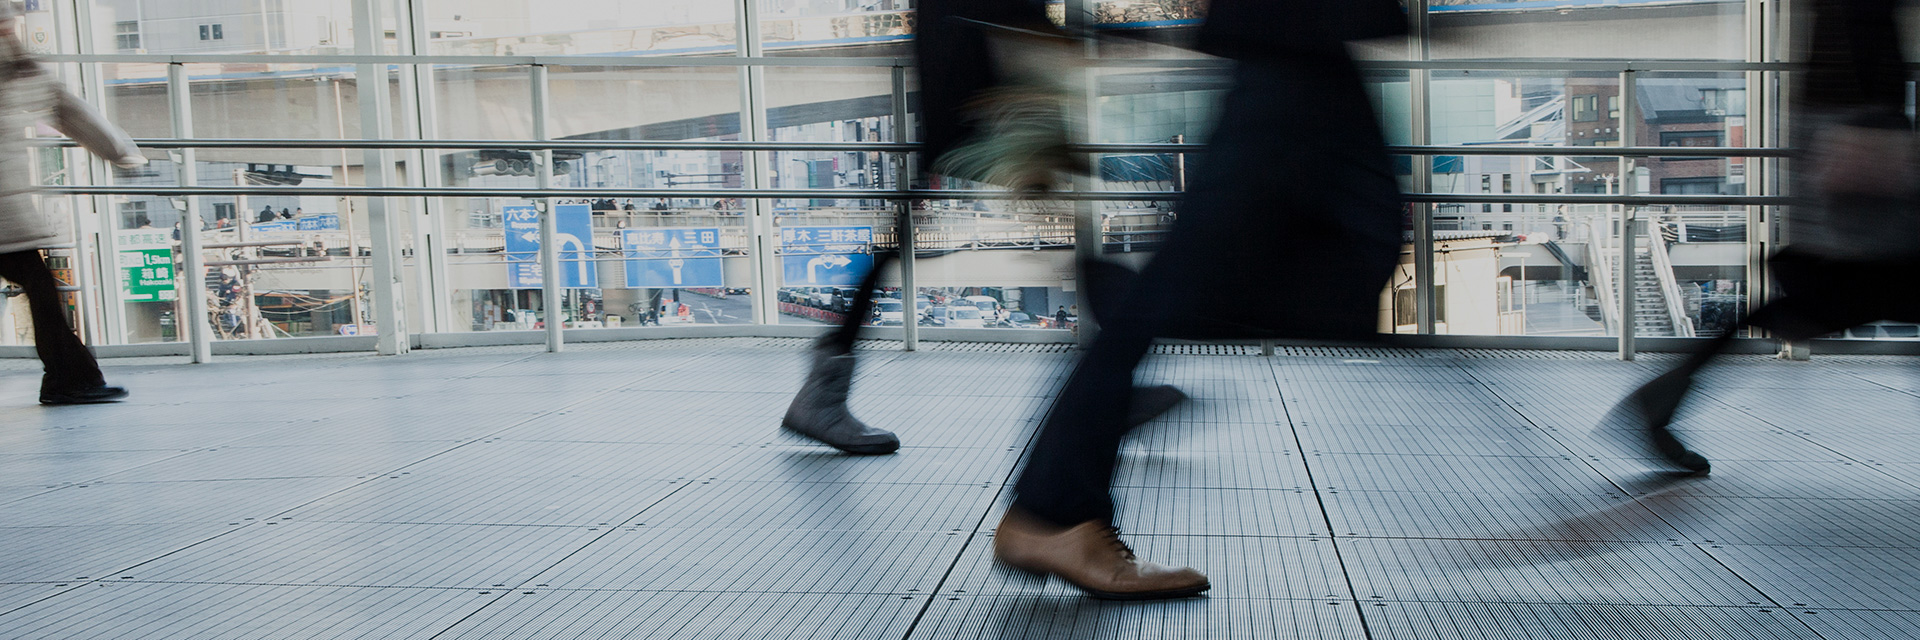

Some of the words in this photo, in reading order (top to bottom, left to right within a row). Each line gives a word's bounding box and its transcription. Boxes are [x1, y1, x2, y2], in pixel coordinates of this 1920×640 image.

[511, 221, 540, 230] Roppong
[626, 232, 665, 245] 恵比寿
[684, 231, 715, 244] 三田
[518, 263, 543, 277] 三宅
